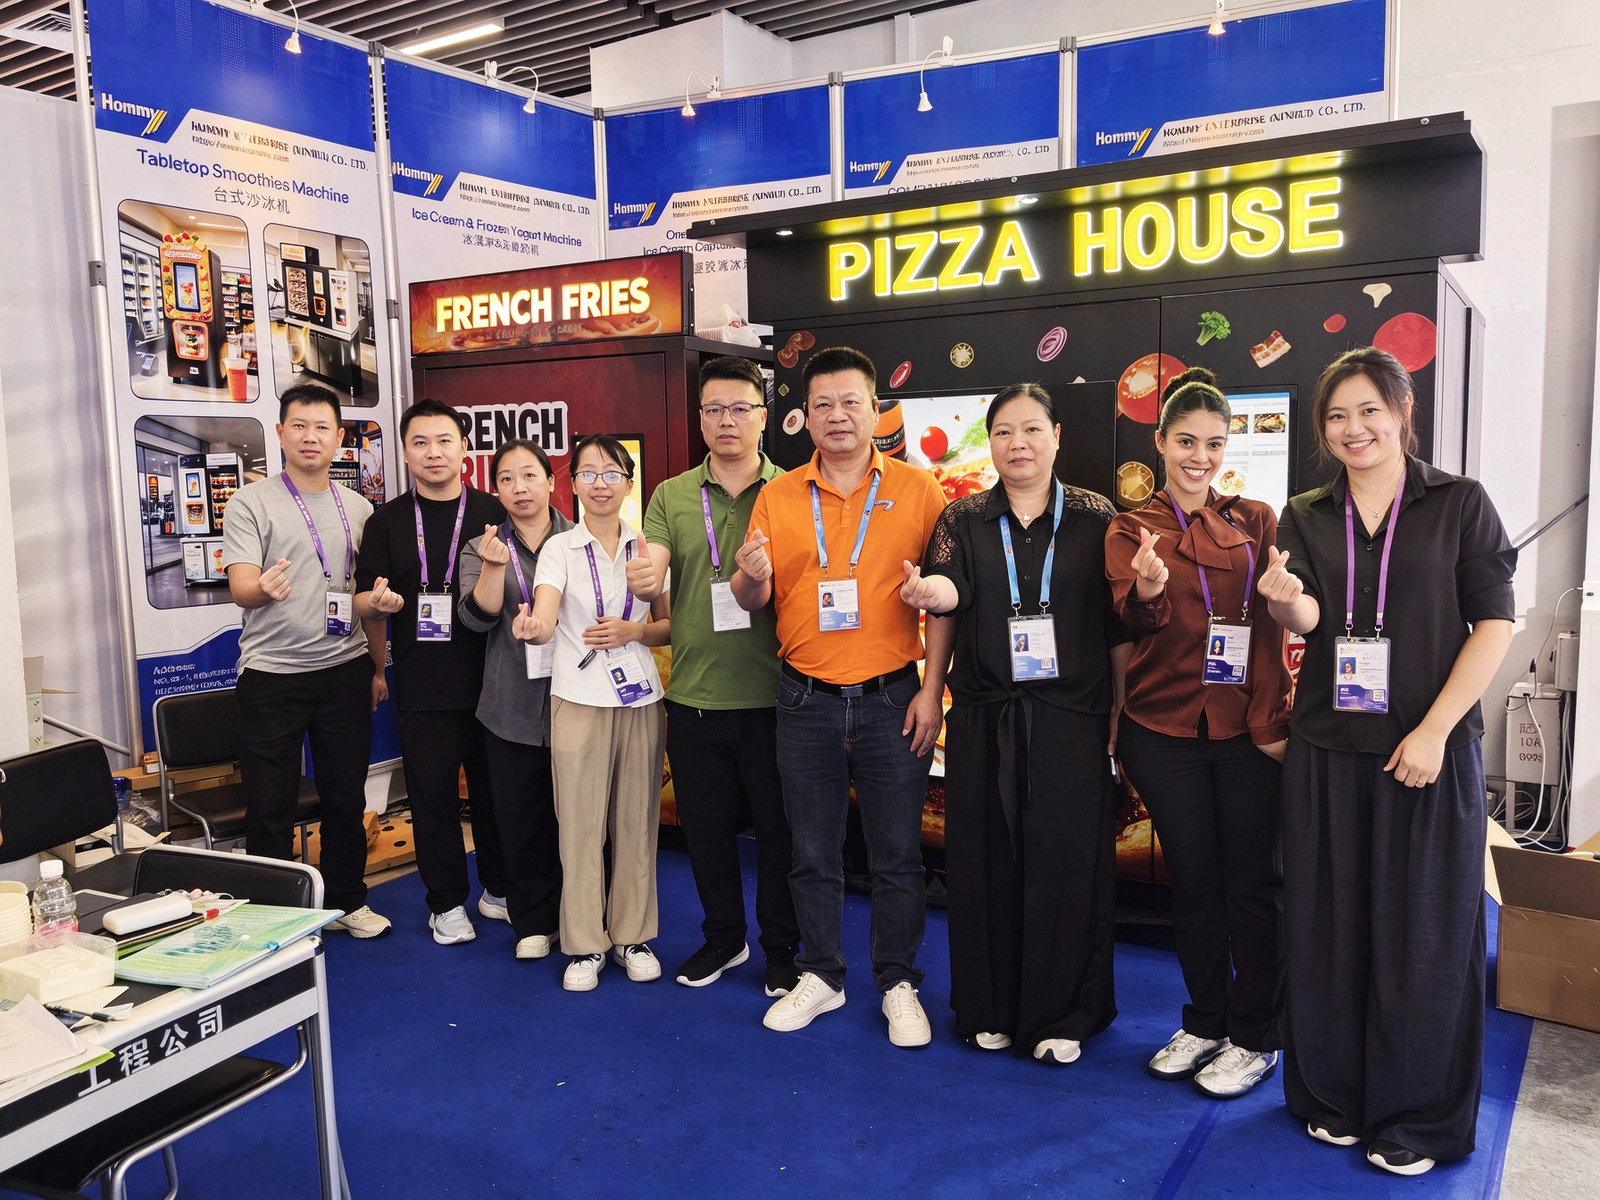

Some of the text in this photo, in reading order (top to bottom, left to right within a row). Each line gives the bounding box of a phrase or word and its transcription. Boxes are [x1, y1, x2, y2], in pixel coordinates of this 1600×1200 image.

[101, 93, 165, 135] Hommy
[1095, 128, 1152, 156] Hommy
[136, 148, 210, 178] Tabletop
[212, 164, 290, 192] Smoothies
[292, 180, 350, 205] Machine
[396, 162, 443, 197] Hommy
[213, 186, 290, 214] 台式沙冰机
[412, 207, 428, 221] Ice
[430, 210, 465, 228] Cream
[466, 217, 474, 229] &
[477, 219, 510, 235] Frozen
[543, 231, 582, 247] Machine
[828, 176, 1345, 303] PIZZA HOUSE
[436, 277, 651, 333] FRENCH FRIES
[461, 407, 563, 451] RENCH
[78, 1004, 224, 1097] 工程公司
